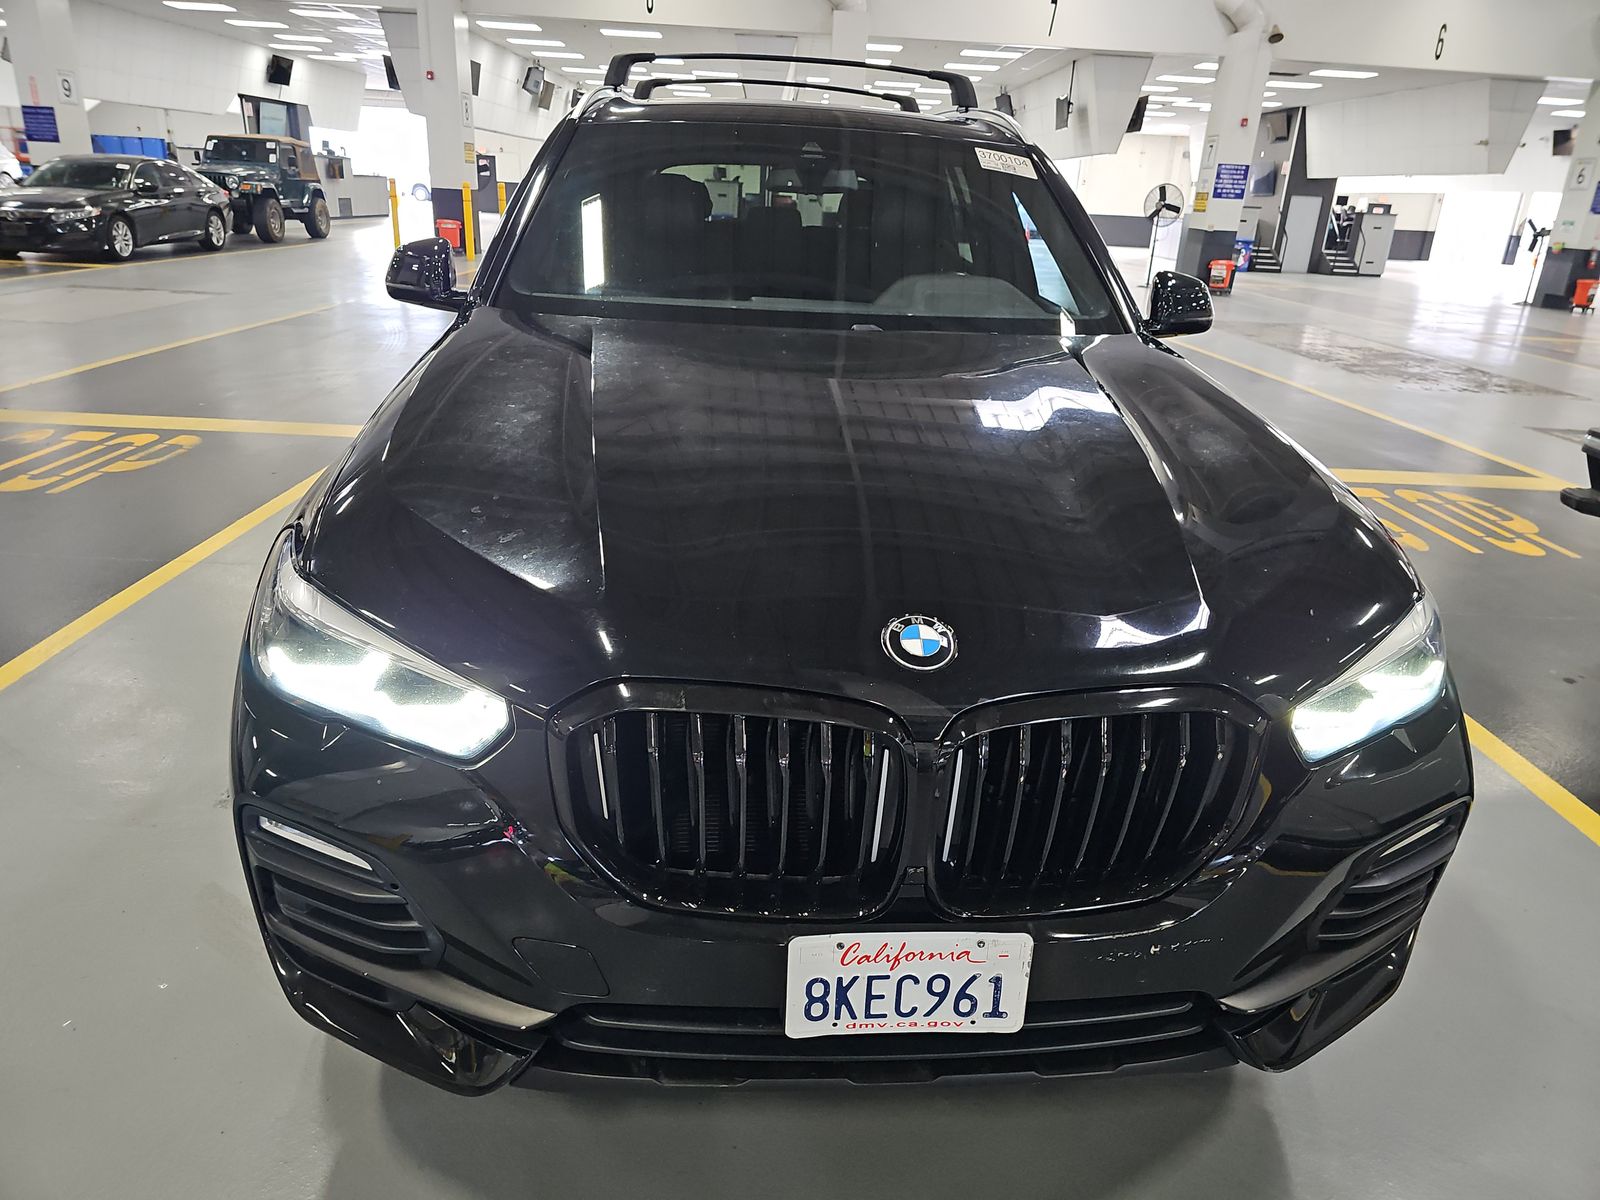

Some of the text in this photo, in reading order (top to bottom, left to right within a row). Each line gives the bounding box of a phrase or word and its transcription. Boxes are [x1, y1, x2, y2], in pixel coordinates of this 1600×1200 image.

[1435, 23, 1447, 61] 6
[61, 78, 71, 98] 9
[978, 150, 1028, 167] 3700104
[1207, 144, 1214, 162] 7
[1576, 167, 1585, 184] 6
[0, 428, 202, 494] TOP
[891, 616, 946, 633] BMW
[839, 941, 987, 971] California
[803, 972, 1009, 1022] 8KEC961
[845, 1020, 965, 1030] dmv.ca.gov
